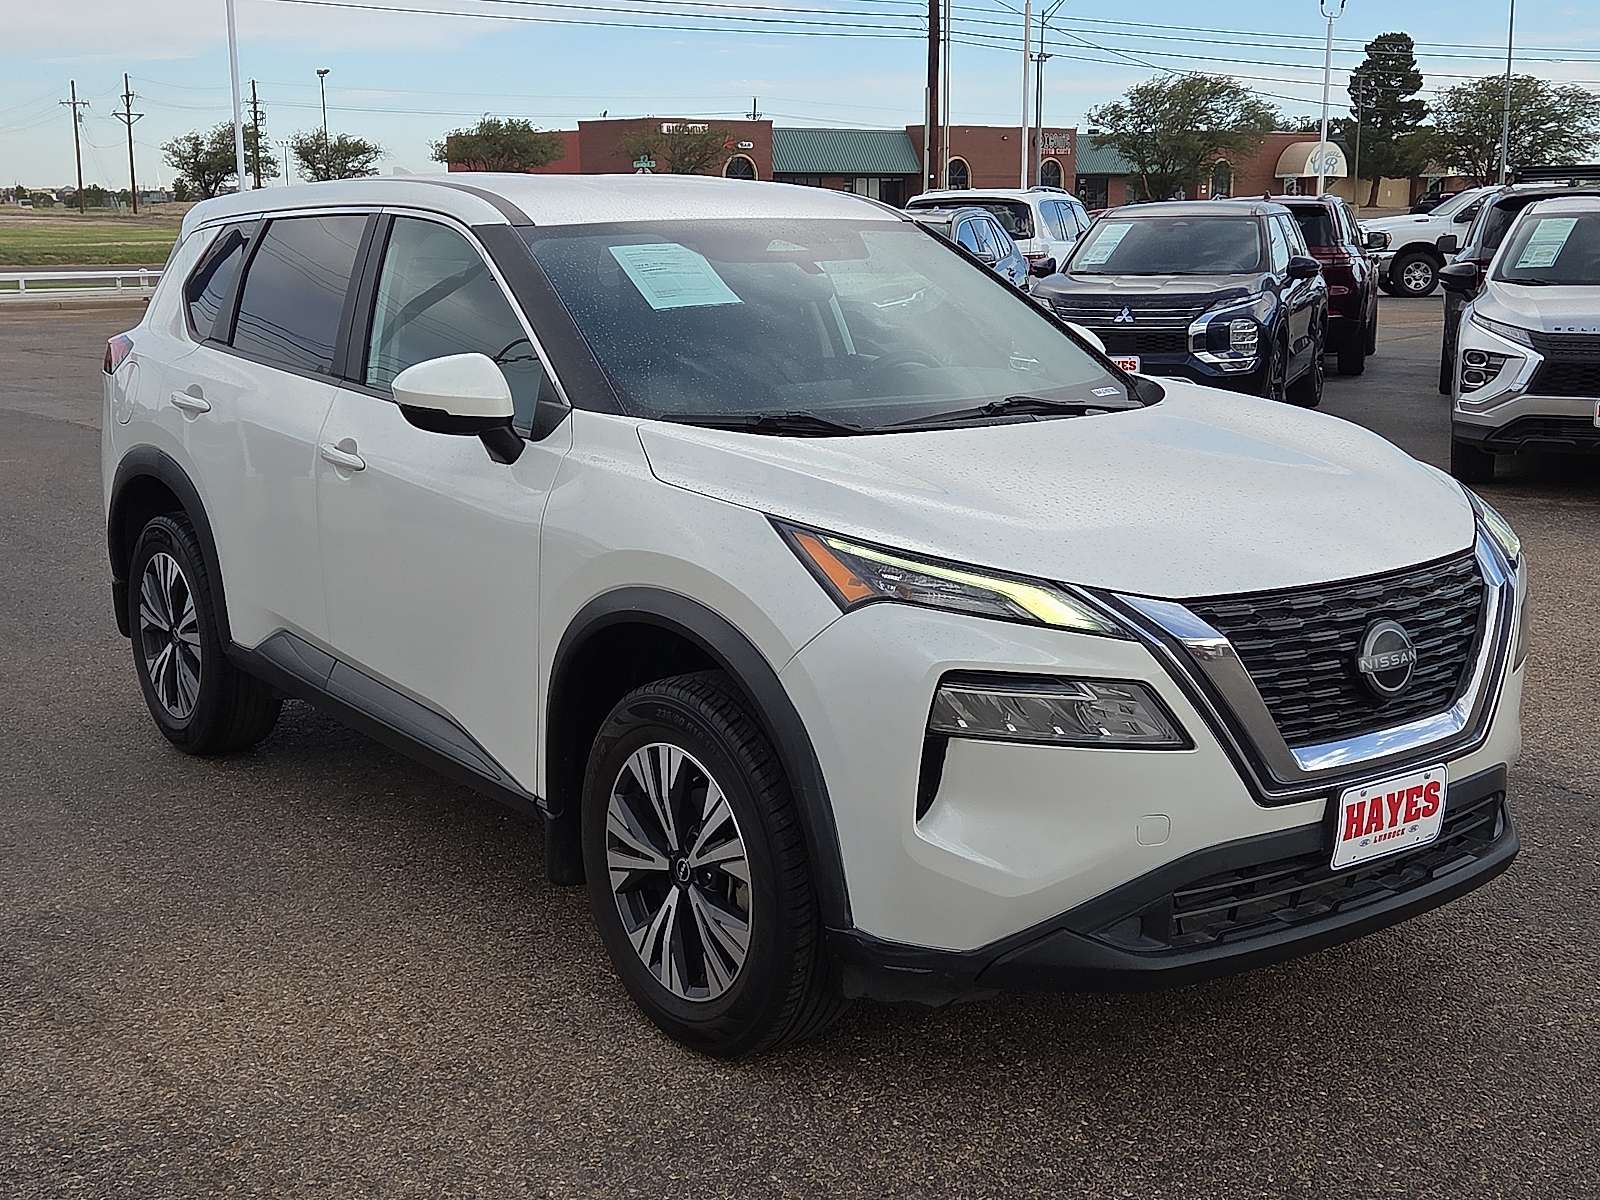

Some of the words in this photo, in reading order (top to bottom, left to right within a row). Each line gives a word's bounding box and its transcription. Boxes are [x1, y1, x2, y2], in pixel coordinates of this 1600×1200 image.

[1360, 650, 1417, 671] NISSAN
[656, 708, 685, 727] 235/60
[685, 722, 704, 741] R18
[1342, 780, 1441, 842] HAYES
